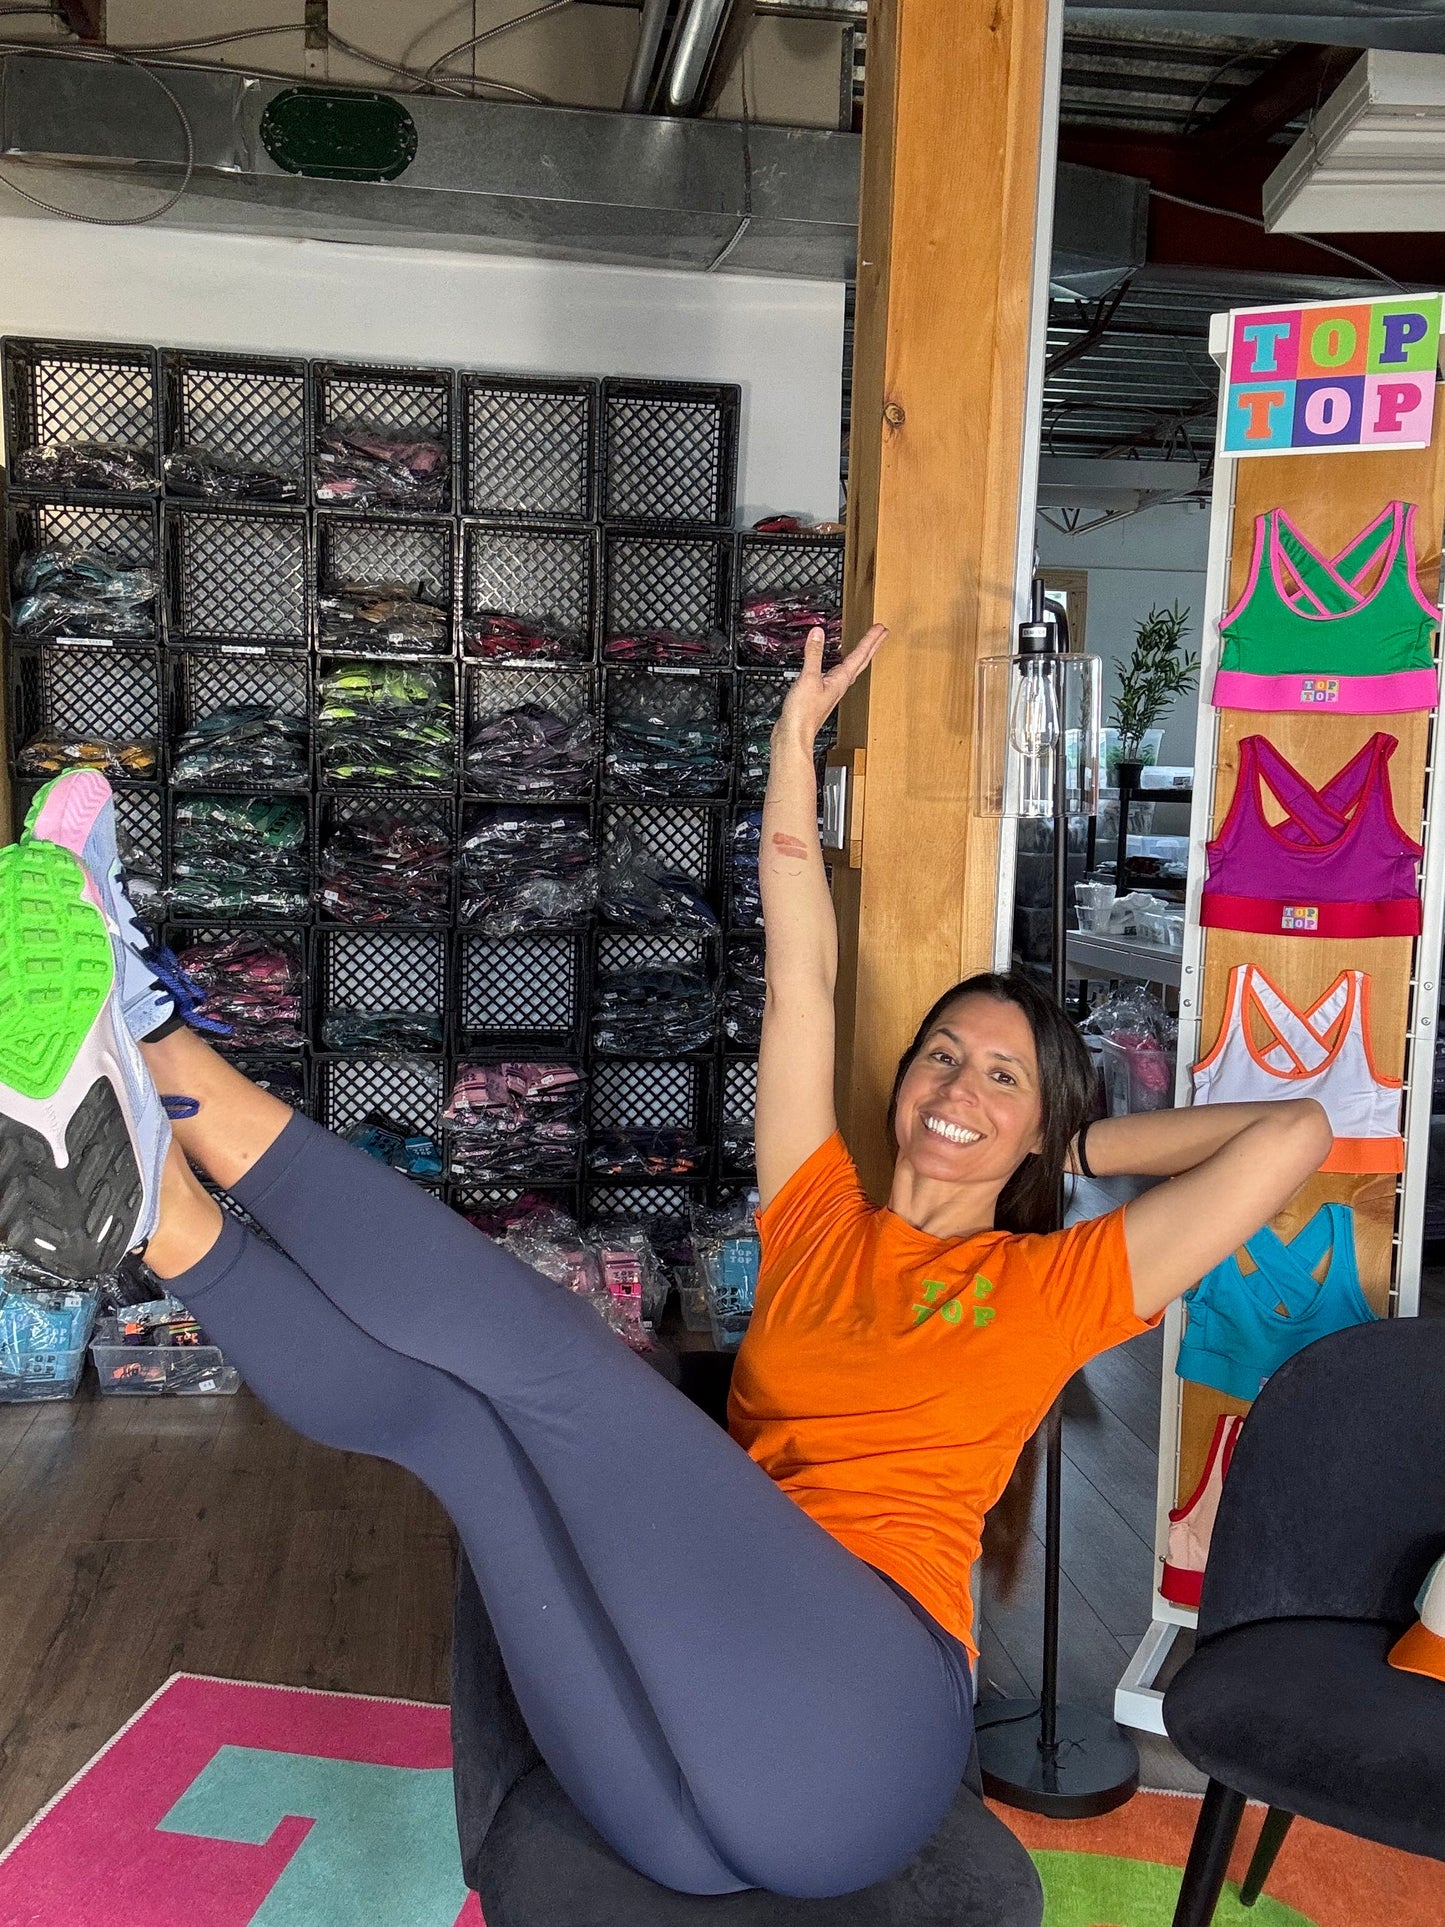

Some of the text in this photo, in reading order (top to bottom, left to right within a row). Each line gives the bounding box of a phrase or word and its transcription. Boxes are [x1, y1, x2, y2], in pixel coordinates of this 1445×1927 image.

[1242, 313, 1428, 373] TOP
[1237, 383, 1422, 440] TOP
[1304, 681, 1336, 690] TOP
[1303, 692, 1336, 701] TOP
[1284, 907, 1315, 917] TOP
[1283, 919, 1315, 928] TOP
[729, 1249, 752, 1257] TOP
[729, 1256, 752, 1264] TOP
[921, 1273, 993, 1302] TP
[912, 1300, 996, 1327] TOP
